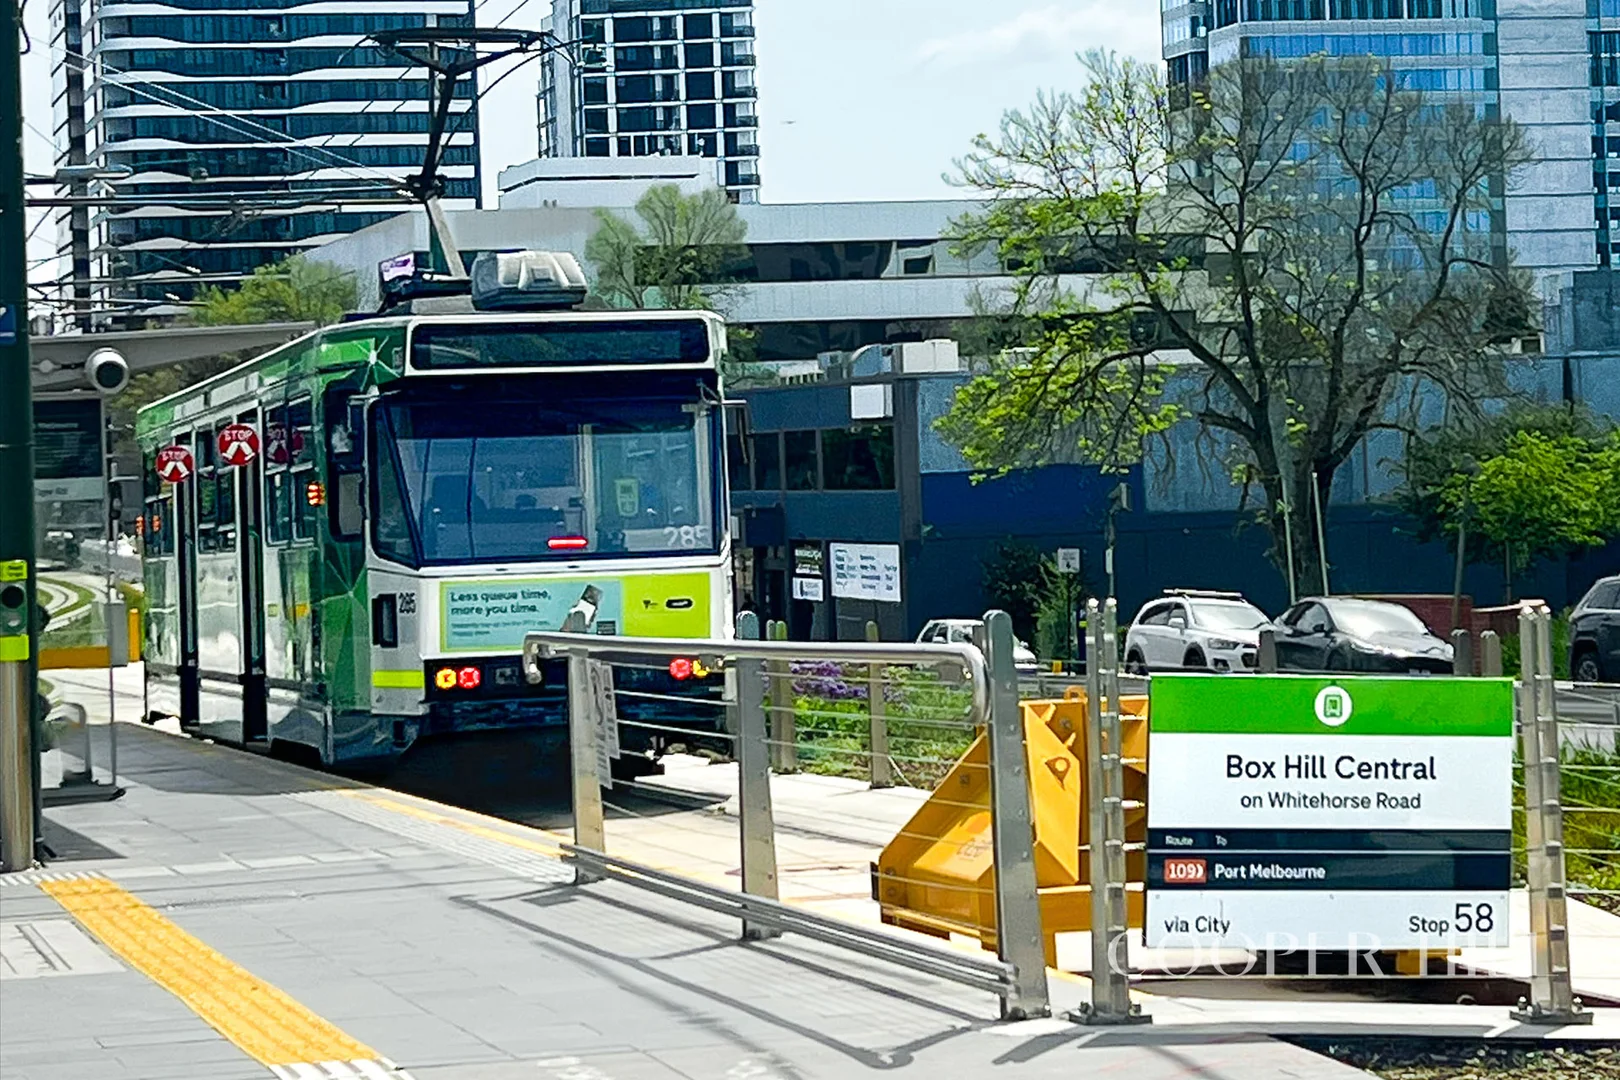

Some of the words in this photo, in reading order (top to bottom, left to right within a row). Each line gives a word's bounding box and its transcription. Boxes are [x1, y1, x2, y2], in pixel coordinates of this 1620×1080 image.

[223, 429, 253, 441] STOP
[450, 591, 478, 602] Less
[481, 591, 518, 602] queue
[521, 588, 552, 600] time,
[451, 606, 483, 615] more
[485, 605, 508, 617] you
[511, 603, 540, 614] time.
[1226, 755, 1276, 779] Box
[1284, 755, 1327, 780] Hill
[1335, 756, 1437, 781] Central
[1240, 796, 1264, 809] on
[1268, 792, 1371, 809] Whitehorse
[1377, 793, 1422, 809] Road
[1165, 834, 1194, 847] Route
[1214, 834, 1228, 847] To
[1214, 863, 1247, 880] Port
[1250, 863, 1327, 880] Melbourne
[1164, 917, 1190, 933] via
[1195, 915, 1231, 936] City
[1409, 917, 1450, 936] Stop
[1454, 903, 1494, 933] 58
